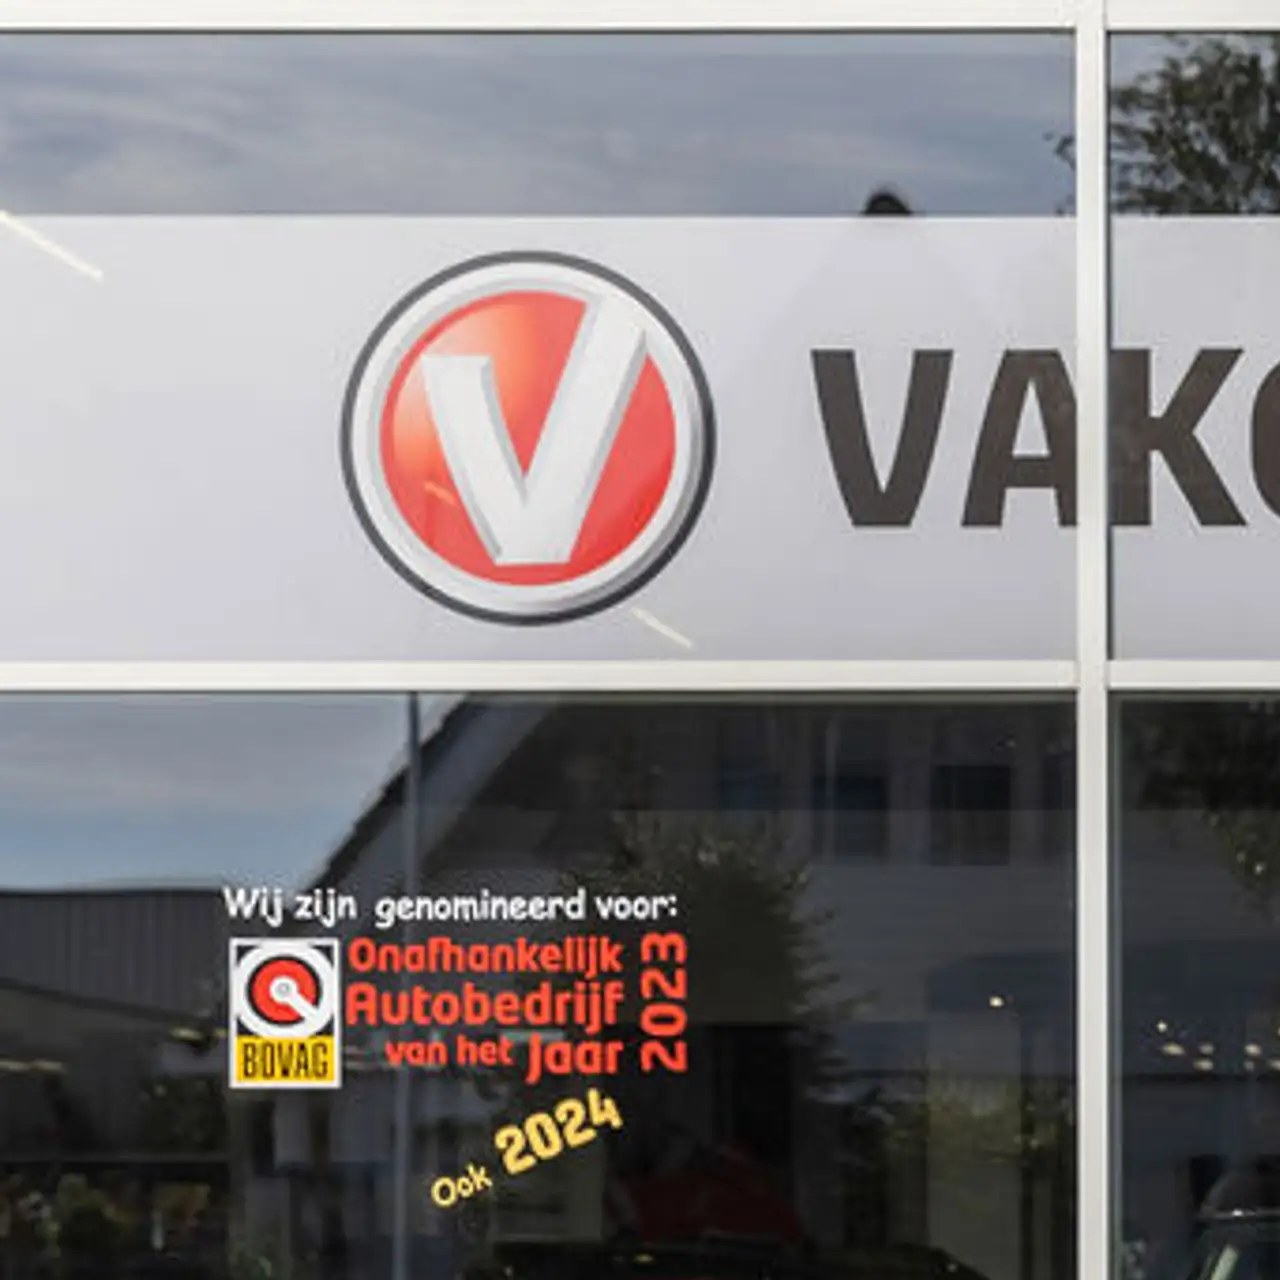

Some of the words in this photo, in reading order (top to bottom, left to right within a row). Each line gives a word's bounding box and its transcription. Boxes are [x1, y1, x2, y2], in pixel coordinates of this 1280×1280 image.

[223, 886, 284, 928] Wij
[296, 888, 357, 927] zijn
[374, 888, 586, 928] genomineerd
[595, 892, 678, 920] voor:
[348, 936, 625, 979] Onafhankelijk
[345, 981, 625, 1034] Autobedrijf
[640, 931, 688, 1073] 2023
[242, 1041, 330, 1079] BOVAG
[384, 1035, 447, 1065] van
[457, 1032, 514, 1065] het
[430, 1164, 493, 1208] Ook
[494, 1088, 625, 1175] 2024
